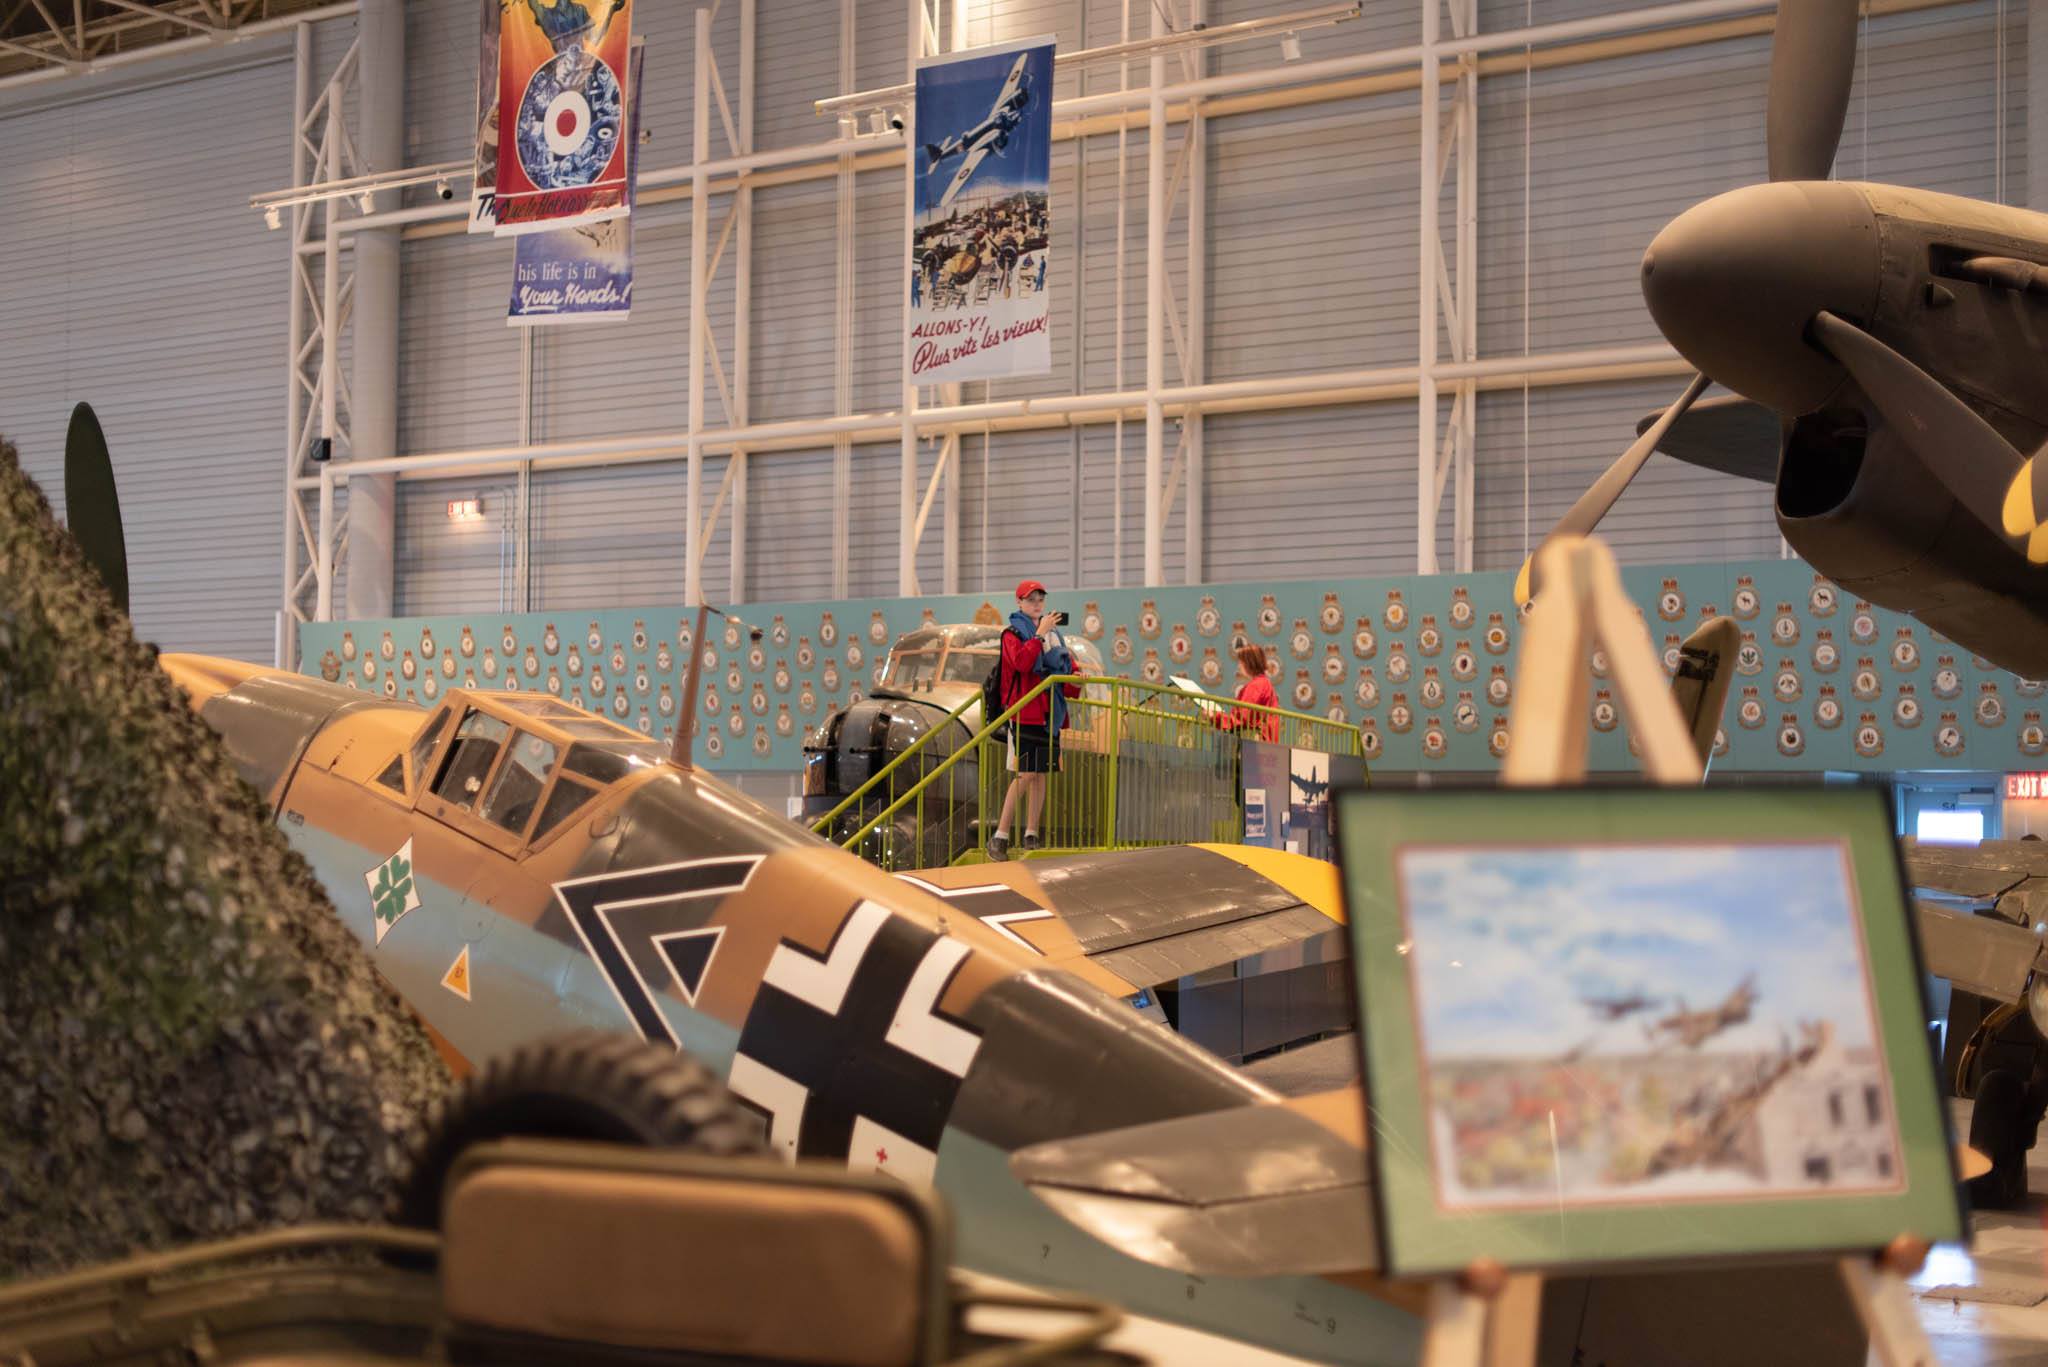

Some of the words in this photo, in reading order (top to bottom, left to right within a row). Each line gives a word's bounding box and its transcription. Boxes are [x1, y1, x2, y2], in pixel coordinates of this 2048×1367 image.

[518, 263, 537, 282] his
[542, 262, 562, 281] life
[567, 261, 579, 280] is
[583, 261, 597, 280] in
[519, 284, 564, 309] Your
[565, 280, 633, 305] Hands!
[911, 316, 987, 338] ALLONS-Y!
[912, 341, 950, 375] Plus
[952, 336, 978, 361] vite
[1003, 310, 1049, 342] vieux!
[2007, 774, 2039, 797] EXIT
